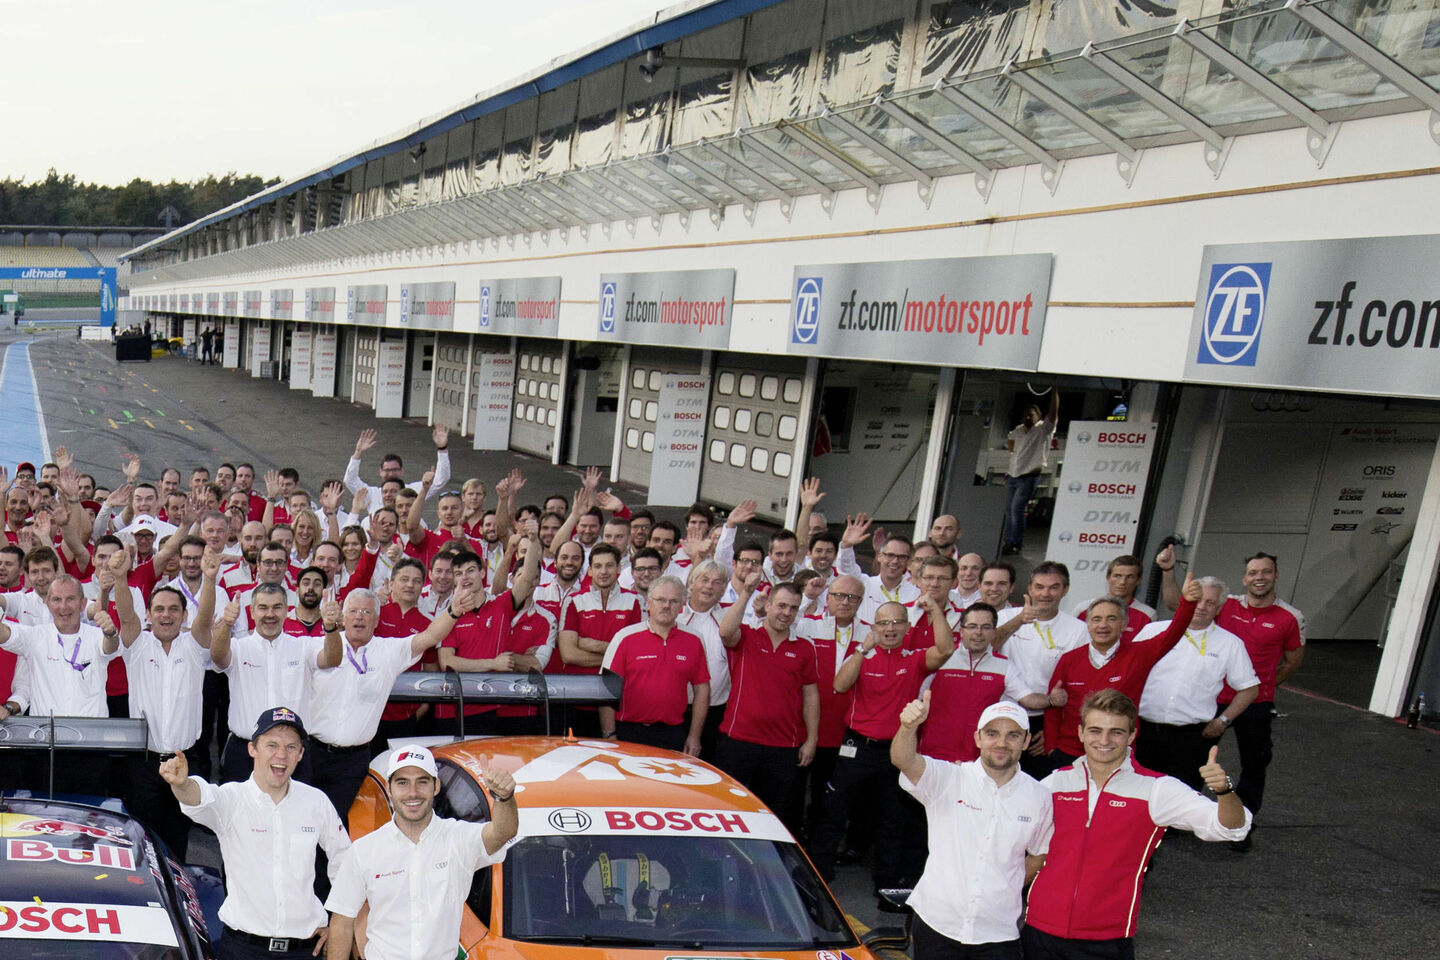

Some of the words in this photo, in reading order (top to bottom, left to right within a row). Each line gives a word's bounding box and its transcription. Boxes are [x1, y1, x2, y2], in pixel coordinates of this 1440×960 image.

[21, 268, 67, 278] ultimate
[625, 291, 726, 333] zf.com/motorsport
[838, 288, 1034, 346] zf.com/motorsport
[677, 381, 705, 389] BOSCH
[676, 398, 703, 407] DTM
[673, 412, 701, 420] BOSCH
[672, 429, 699, 438] DTM
[1097, 432, 1147, 444] BOSCH
[670, 443, 698, 451] BOSCH
[668, 460, 696, 468] DTM
[1092, 460, 1142, 473] DTM
[1363, 465, 1396, 476] ORIS
[1087, 483, 1136, 495] BOSCH
[1083, 510, 1131, 524] DTM
[1078, 533, 1127, 544] BOSCH
[404, 751, 425, 761] RS
[604, 810, 750, 834] BOSCH
[6, 839, 136, 871] Bull
